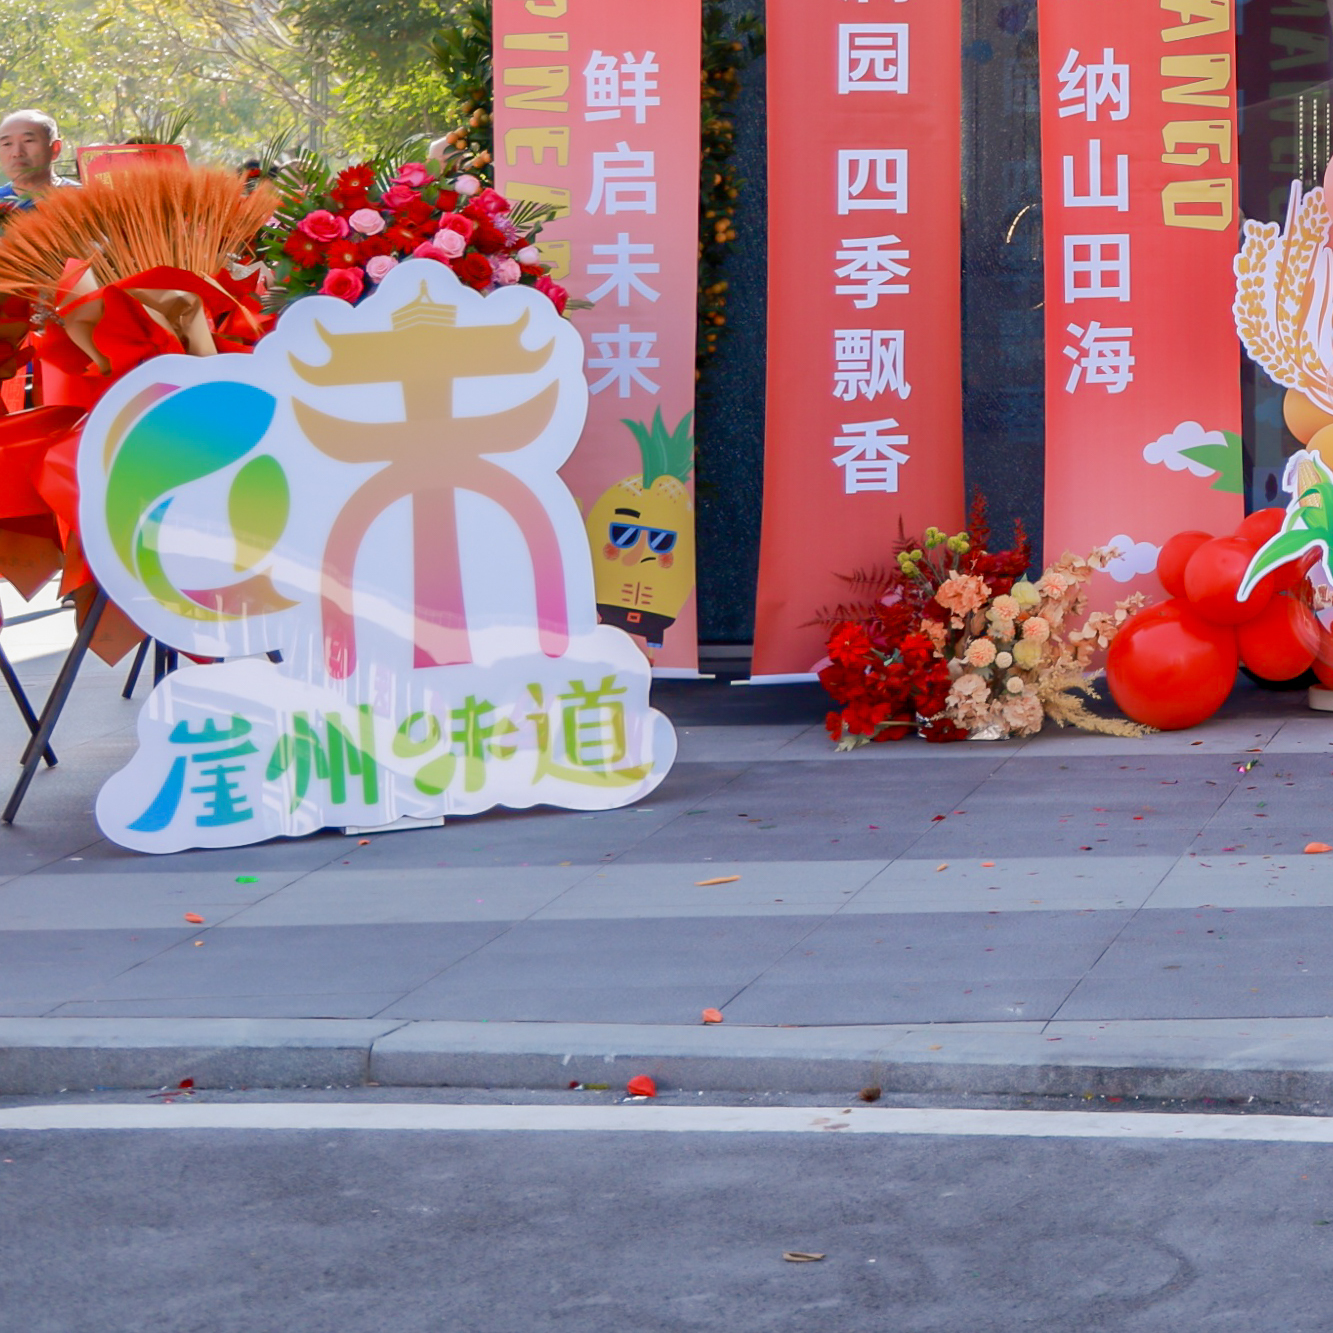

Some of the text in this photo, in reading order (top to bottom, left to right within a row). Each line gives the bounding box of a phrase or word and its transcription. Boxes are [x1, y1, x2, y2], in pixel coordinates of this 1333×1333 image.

[583, 49, 661, 399] 鲜启未来
[832, 148, 912, 495] 四季飘香
[1057, 49, 1135, 396] 纳山田海
[127, 674, 655, 833] 崖州味道
